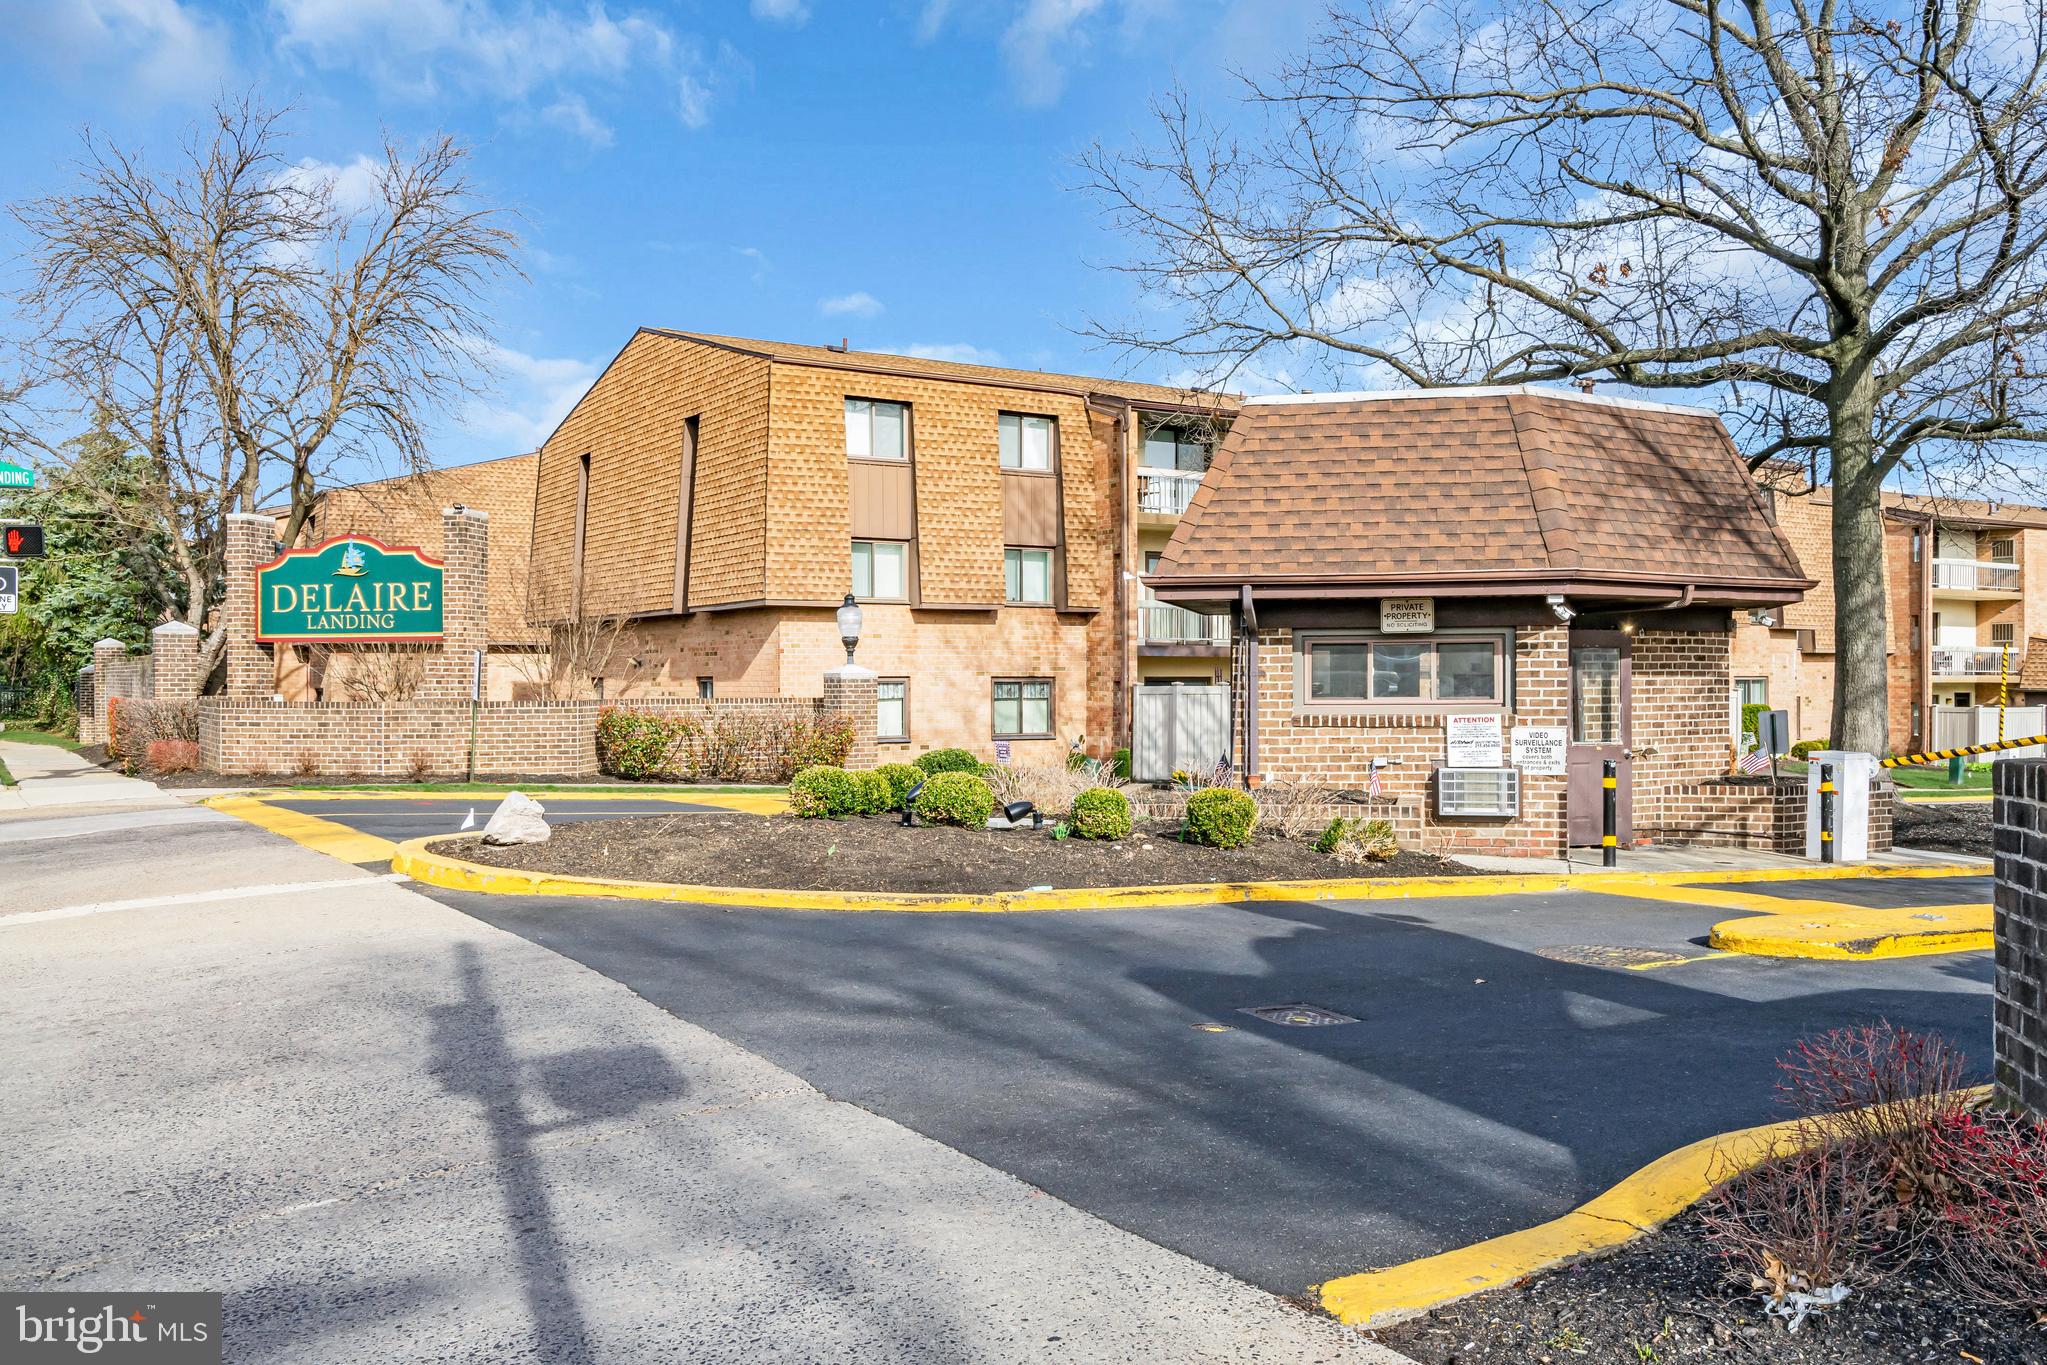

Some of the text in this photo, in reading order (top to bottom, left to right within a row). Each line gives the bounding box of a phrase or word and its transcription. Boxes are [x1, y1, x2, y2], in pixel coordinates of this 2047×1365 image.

[271, 581, 433, 613] DELAIRE
[1390, 603, 1424, 611] PRIVATE
[1386, 612, 1428, 620] PROPERTY
[306, 613, 395, 630] LANDING
[1453, 716, 1495, 724] ATTENTION
[1529, 731, 1549, 739] VIDEO
[1514, 739, 1563, 747] SURVEILLANCE
[1525, 746, 1552, 754] SYSTEM
